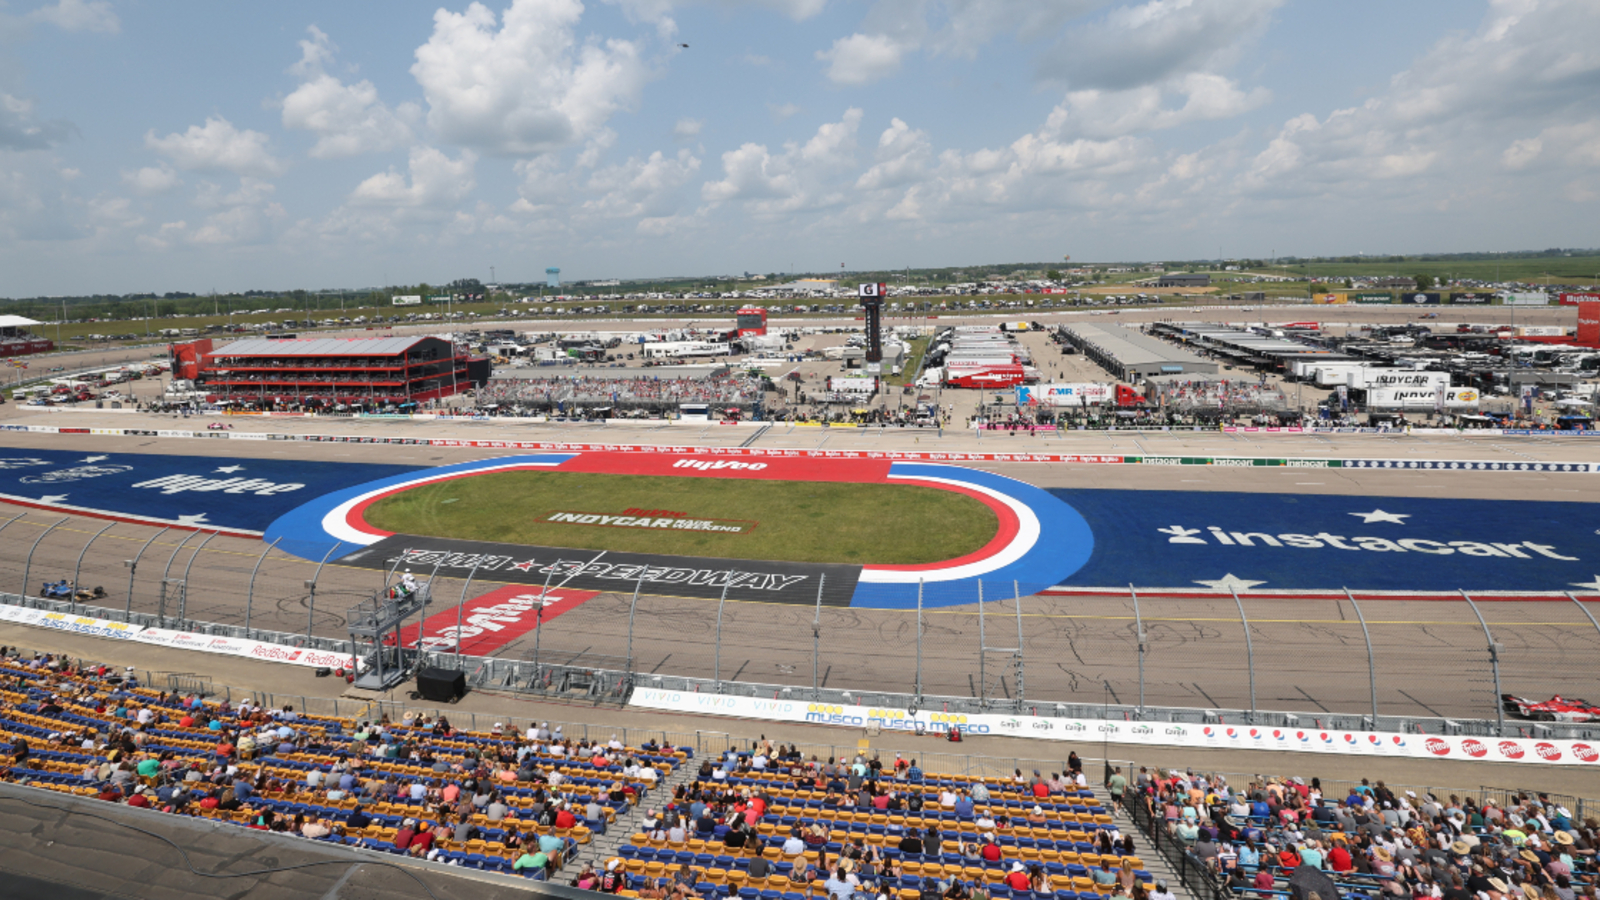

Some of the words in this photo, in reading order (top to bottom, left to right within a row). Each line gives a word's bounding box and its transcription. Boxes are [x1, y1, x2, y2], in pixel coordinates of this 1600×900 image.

[1376, 376, 1429, 384] INDYCAR
[1394, 392, 1456, 400] INDYCR
[548, 512, 674, 528] INDYCAR
[1207, 526, 1580, 561] instacart
[539, 562, 809, 590] SPEEDWAY
[252, 645, 290, 660] RedBox
[304, 652, 346, 667] RedBox
[644, 692, 680, 702] VIVID
[698, 696, 736, 708] VIVID
[754, 701, 792, 712] VIVID
